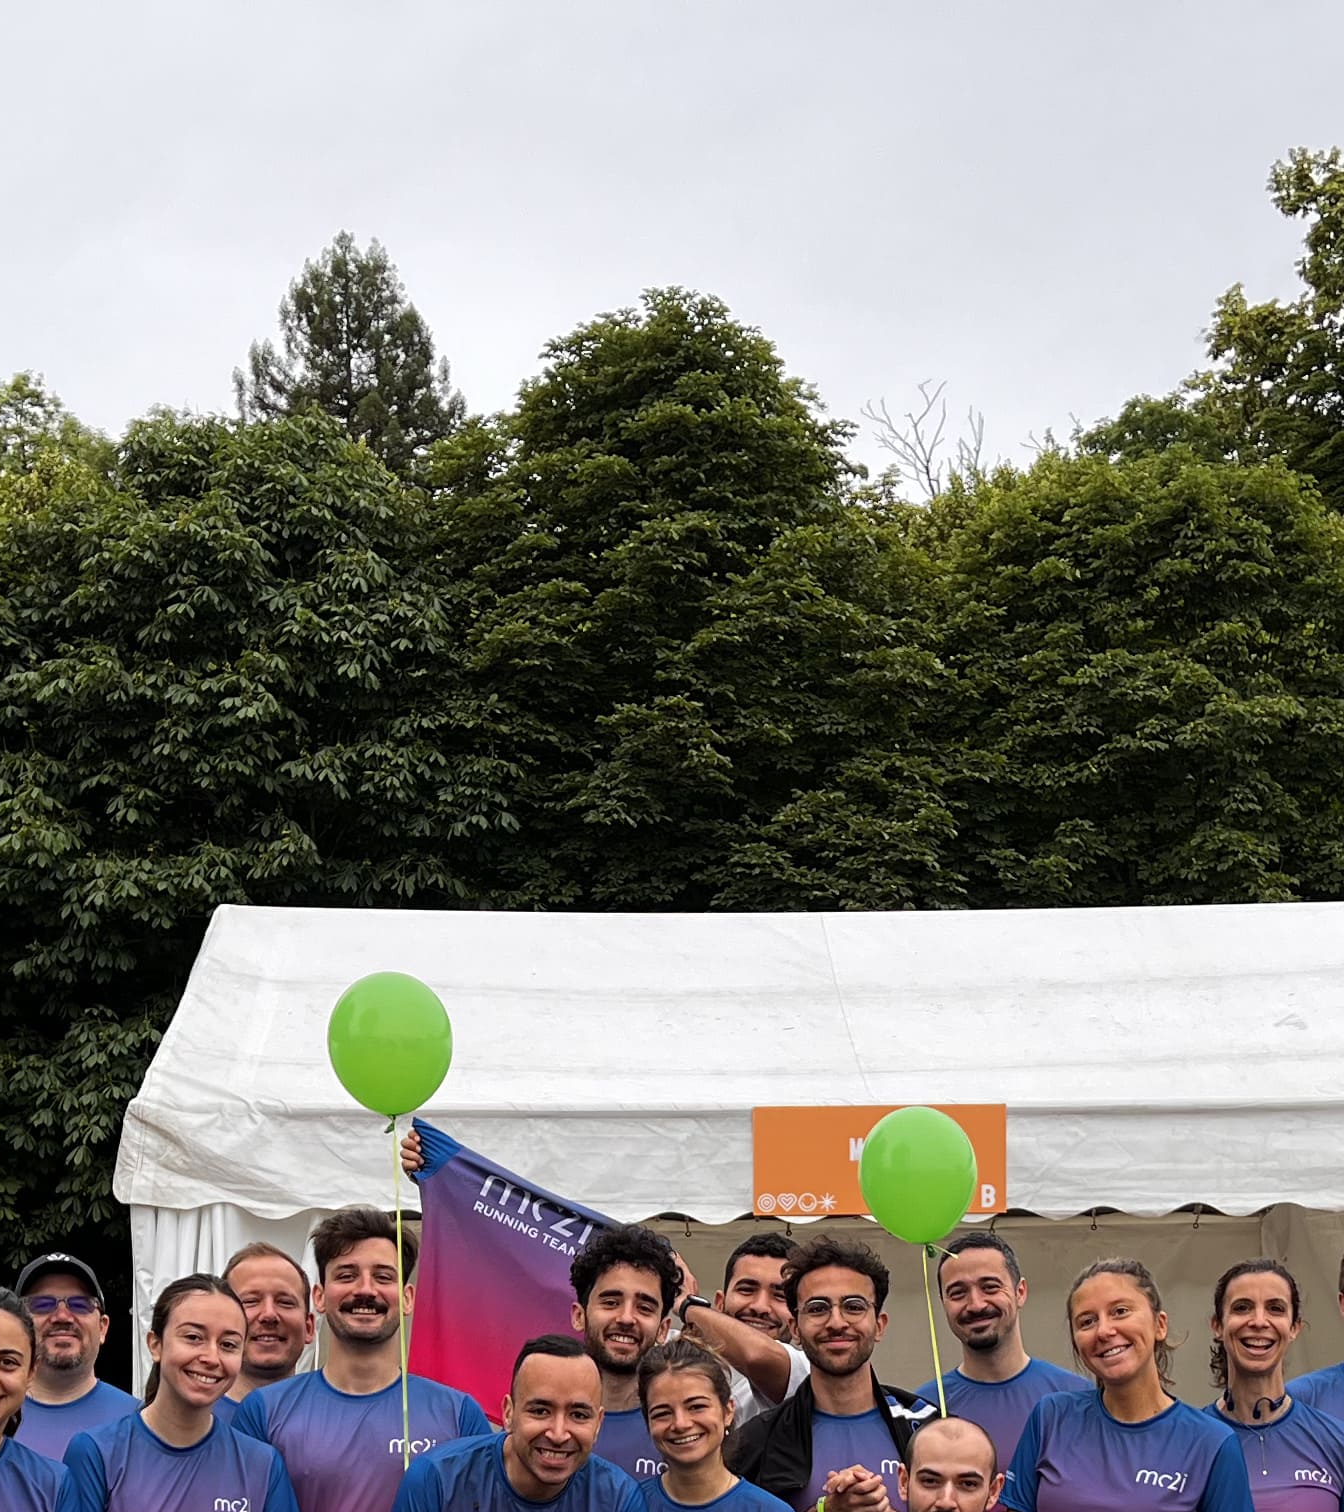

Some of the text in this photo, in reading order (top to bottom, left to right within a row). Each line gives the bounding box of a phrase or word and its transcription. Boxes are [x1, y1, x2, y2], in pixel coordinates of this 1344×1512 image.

[981, 1184, 996, 1208] B
[473, 1201, 539, 1239] RUNNING
[480, 1175, 594, 1245] mc2i
[636, 1458, 669, 1476] mc
[1294, 1468, 1332, 1485] mc2i
[1135, 1468, 1188, 1494] mc2i
